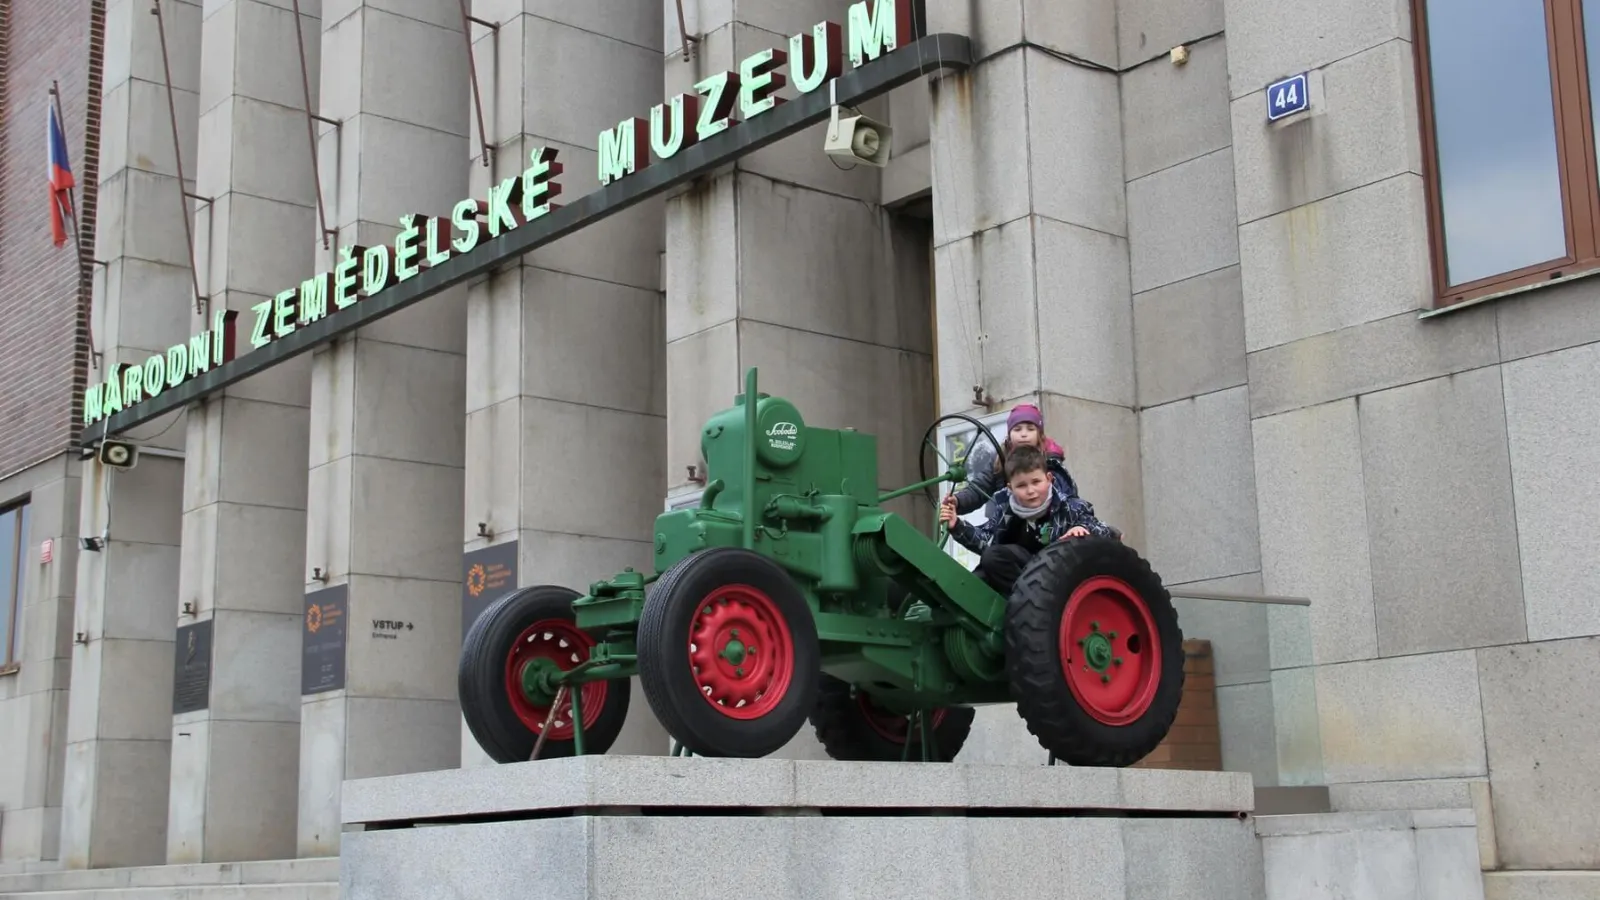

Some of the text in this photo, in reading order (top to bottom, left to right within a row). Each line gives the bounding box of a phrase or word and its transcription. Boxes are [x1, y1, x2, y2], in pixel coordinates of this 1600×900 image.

[1275, 84, 1298, 109] 44
[84, 0, 897, 427] NÁRODNÍ ZEMĚDĚLSKÉ MUZEUM
[372, 619, 404, 630] VSTUP
